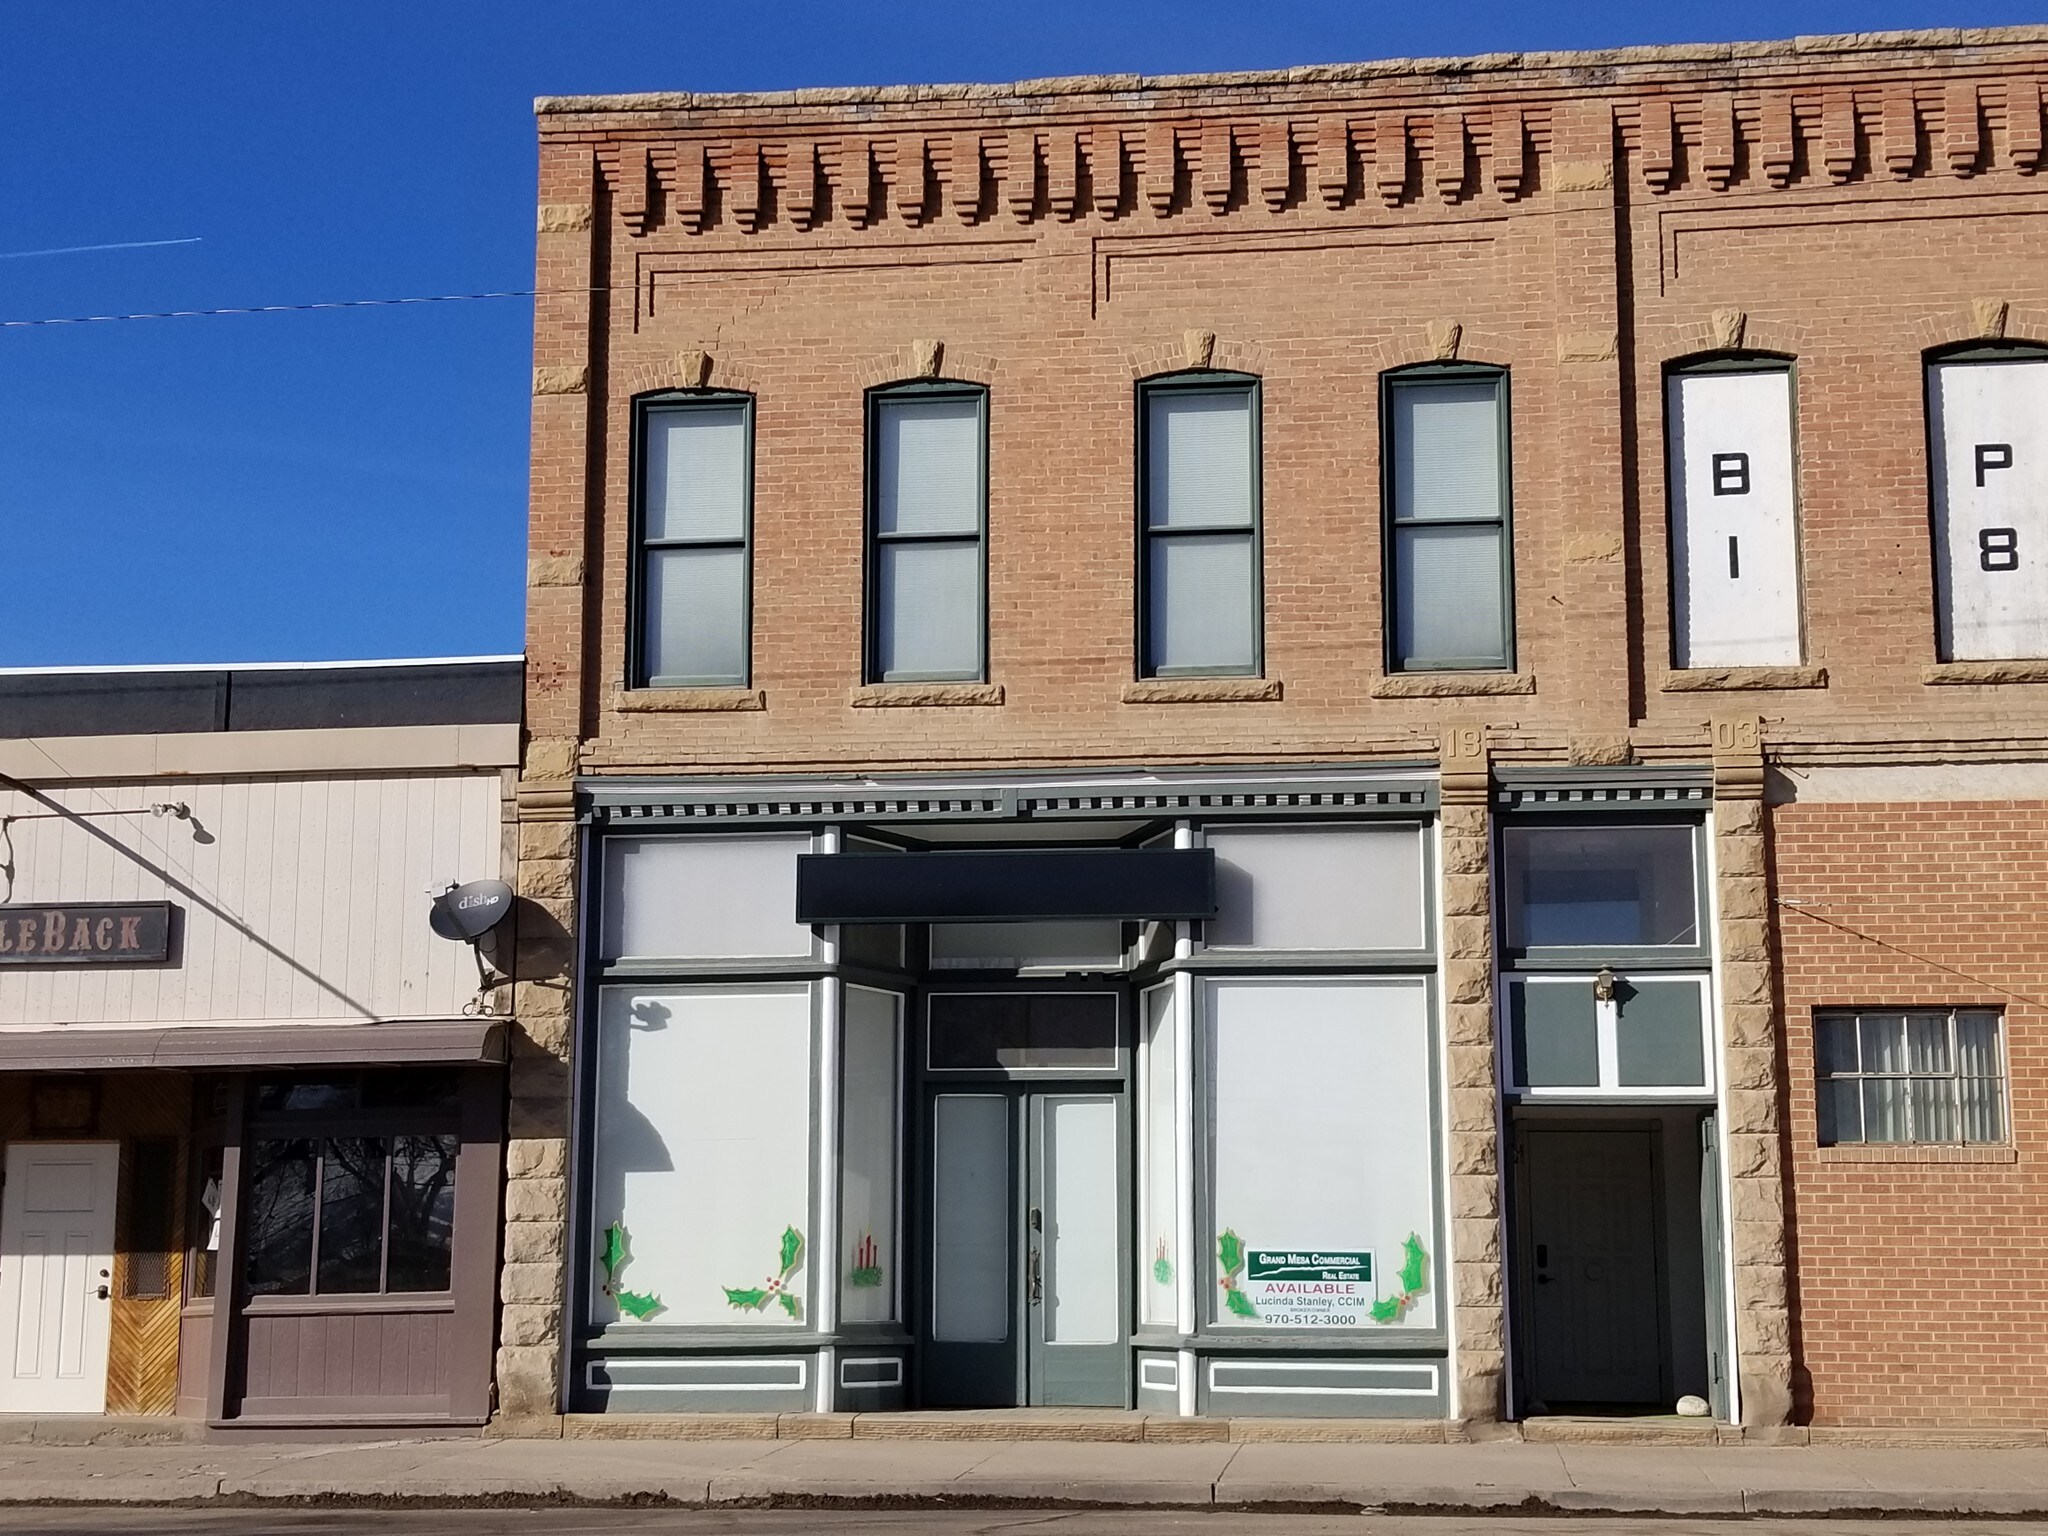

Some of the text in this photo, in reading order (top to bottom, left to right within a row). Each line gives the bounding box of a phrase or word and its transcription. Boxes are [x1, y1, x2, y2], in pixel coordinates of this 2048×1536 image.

[1974, 443, 2013, 488] P
[1712, 452, 1751, 497] B
[1978, 527, 2019, 572] 8
[1447, 728, 1482, 758] 19
[1259, 1253, 1361, 1265] GRAND MESA COMMERCIAL
[1322, 1271, 1359, 1280] REAL ESTATE
[1265, 1283, 1356, 1294] AVAILABLE
[1255, 1296, 1365, 1308] Lucinda Stanley, CCIM
[1264, 1314, 1357, 1325] 970-512-3000
